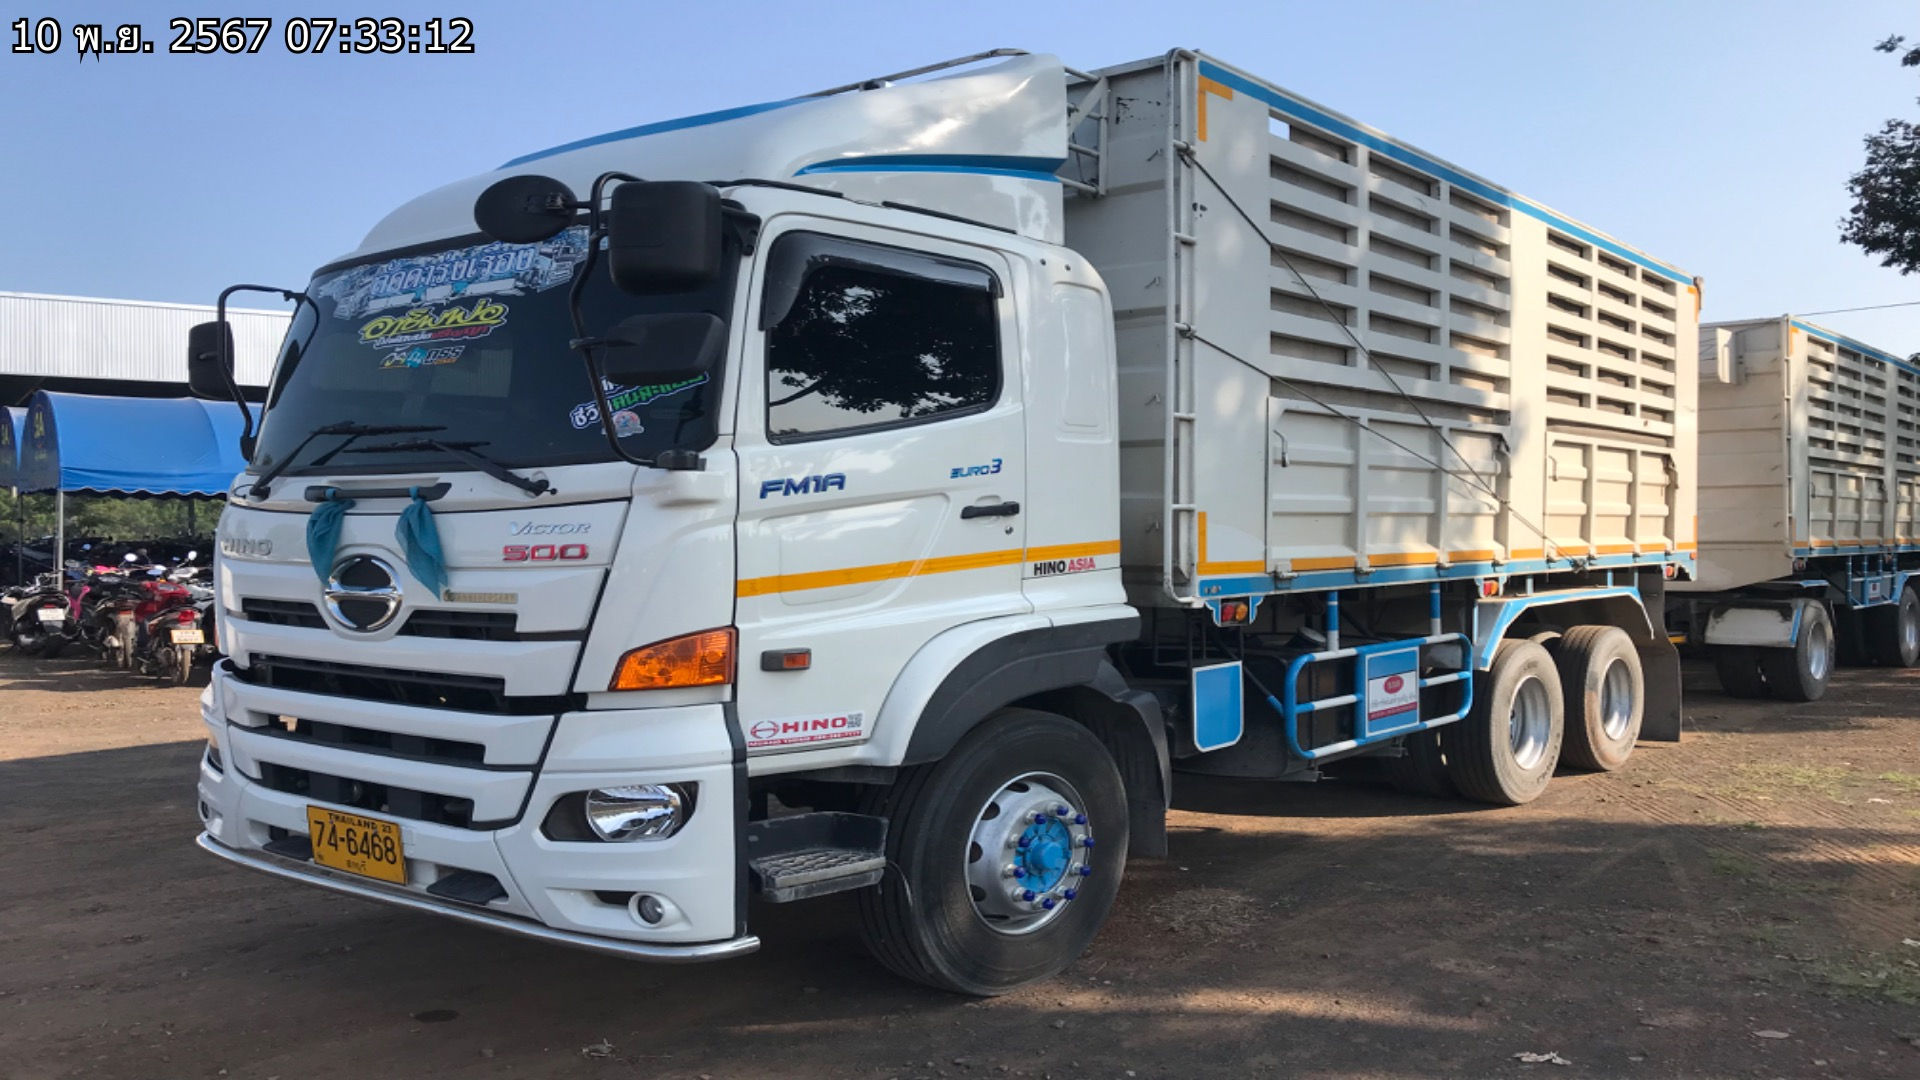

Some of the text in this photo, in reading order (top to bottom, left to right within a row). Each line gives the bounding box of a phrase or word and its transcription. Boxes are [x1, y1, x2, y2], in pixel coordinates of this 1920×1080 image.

[759, 473, 846, 499] FM1A
[503, 544, 589, 560] 500
[1033, 557, 1097, 576] HINO ASIA
[782, 717, 848, 733] HINO
[314, 820, 397, 865] 74-6468
